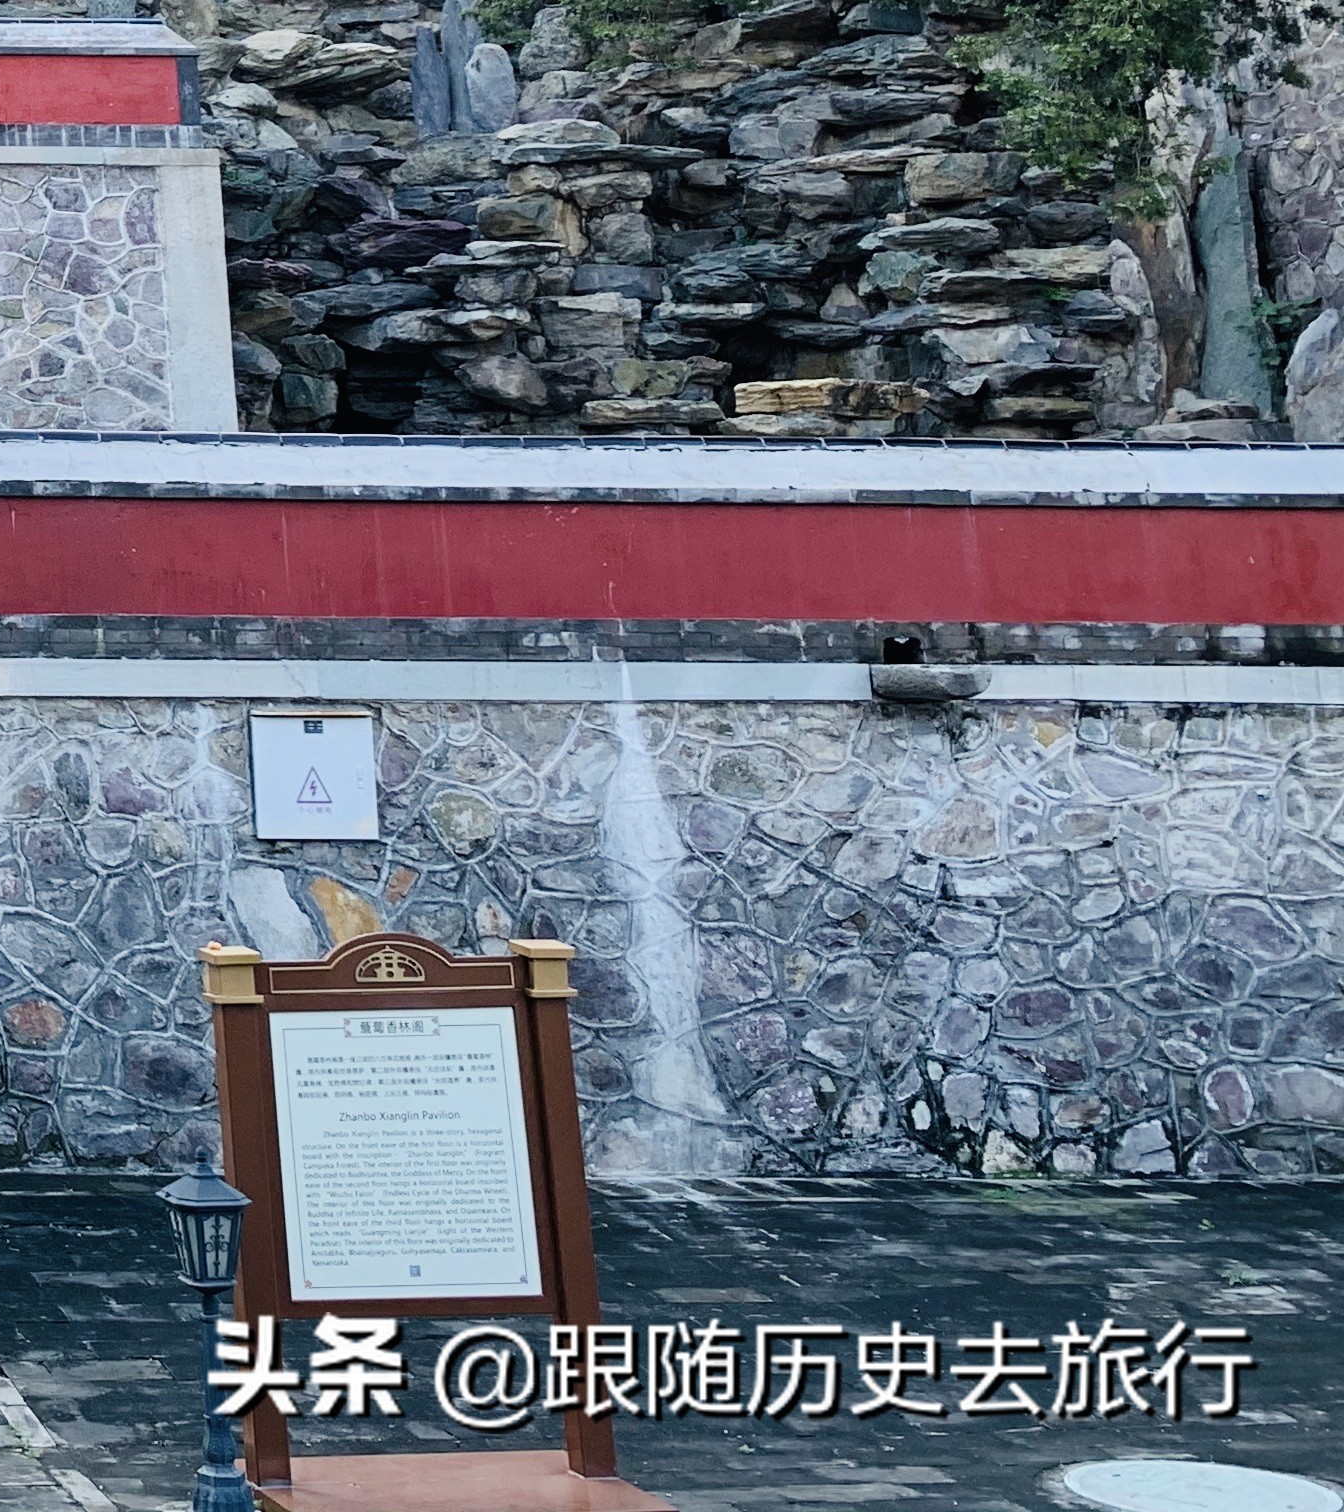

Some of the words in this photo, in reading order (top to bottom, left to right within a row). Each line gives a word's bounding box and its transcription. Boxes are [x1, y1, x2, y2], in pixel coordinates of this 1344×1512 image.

[338, 1111, 377, 1121] Zhanbo
[379, 1110, 420, 1123] Xianglin
[421, 1109, 461, 1120] Pavilion
